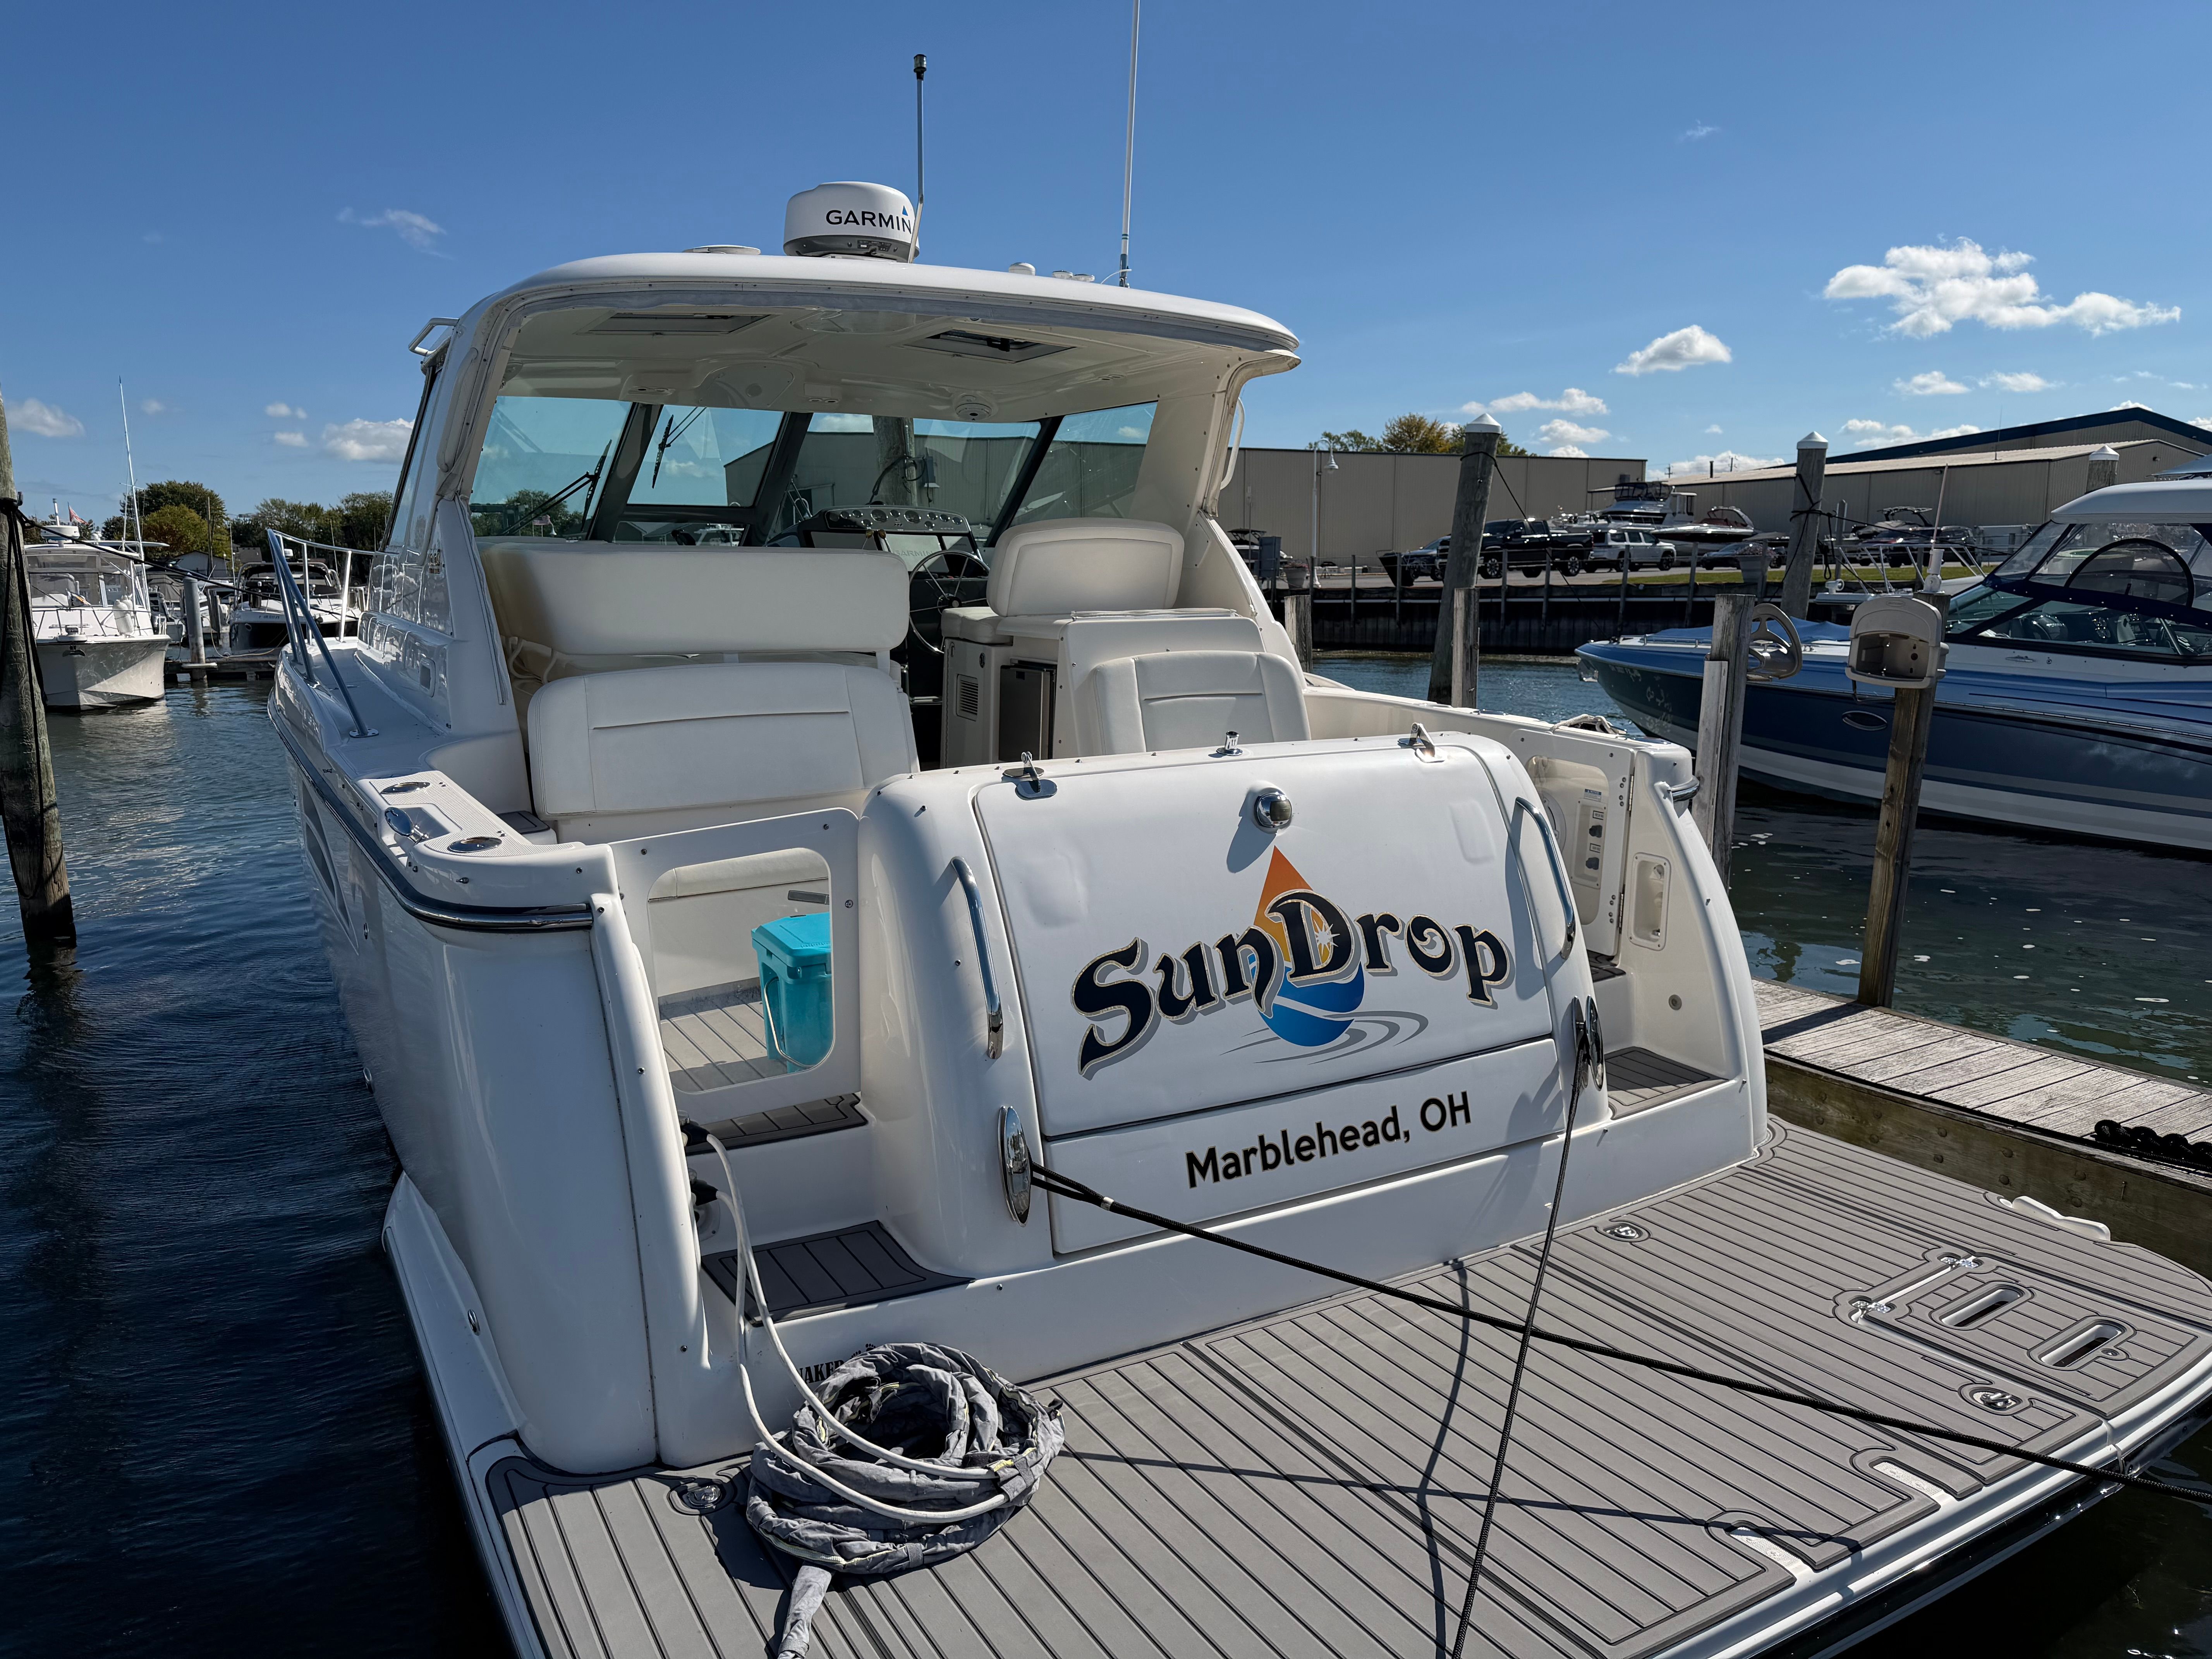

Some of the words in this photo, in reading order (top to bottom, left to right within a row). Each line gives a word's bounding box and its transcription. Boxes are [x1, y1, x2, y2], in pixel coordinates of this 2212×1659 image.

[826, 210, 912, 235] GARMIN
[1185, 1105, 1411, 1190] Marblehead,
[1419, 1090, 1473, 1133] OH
